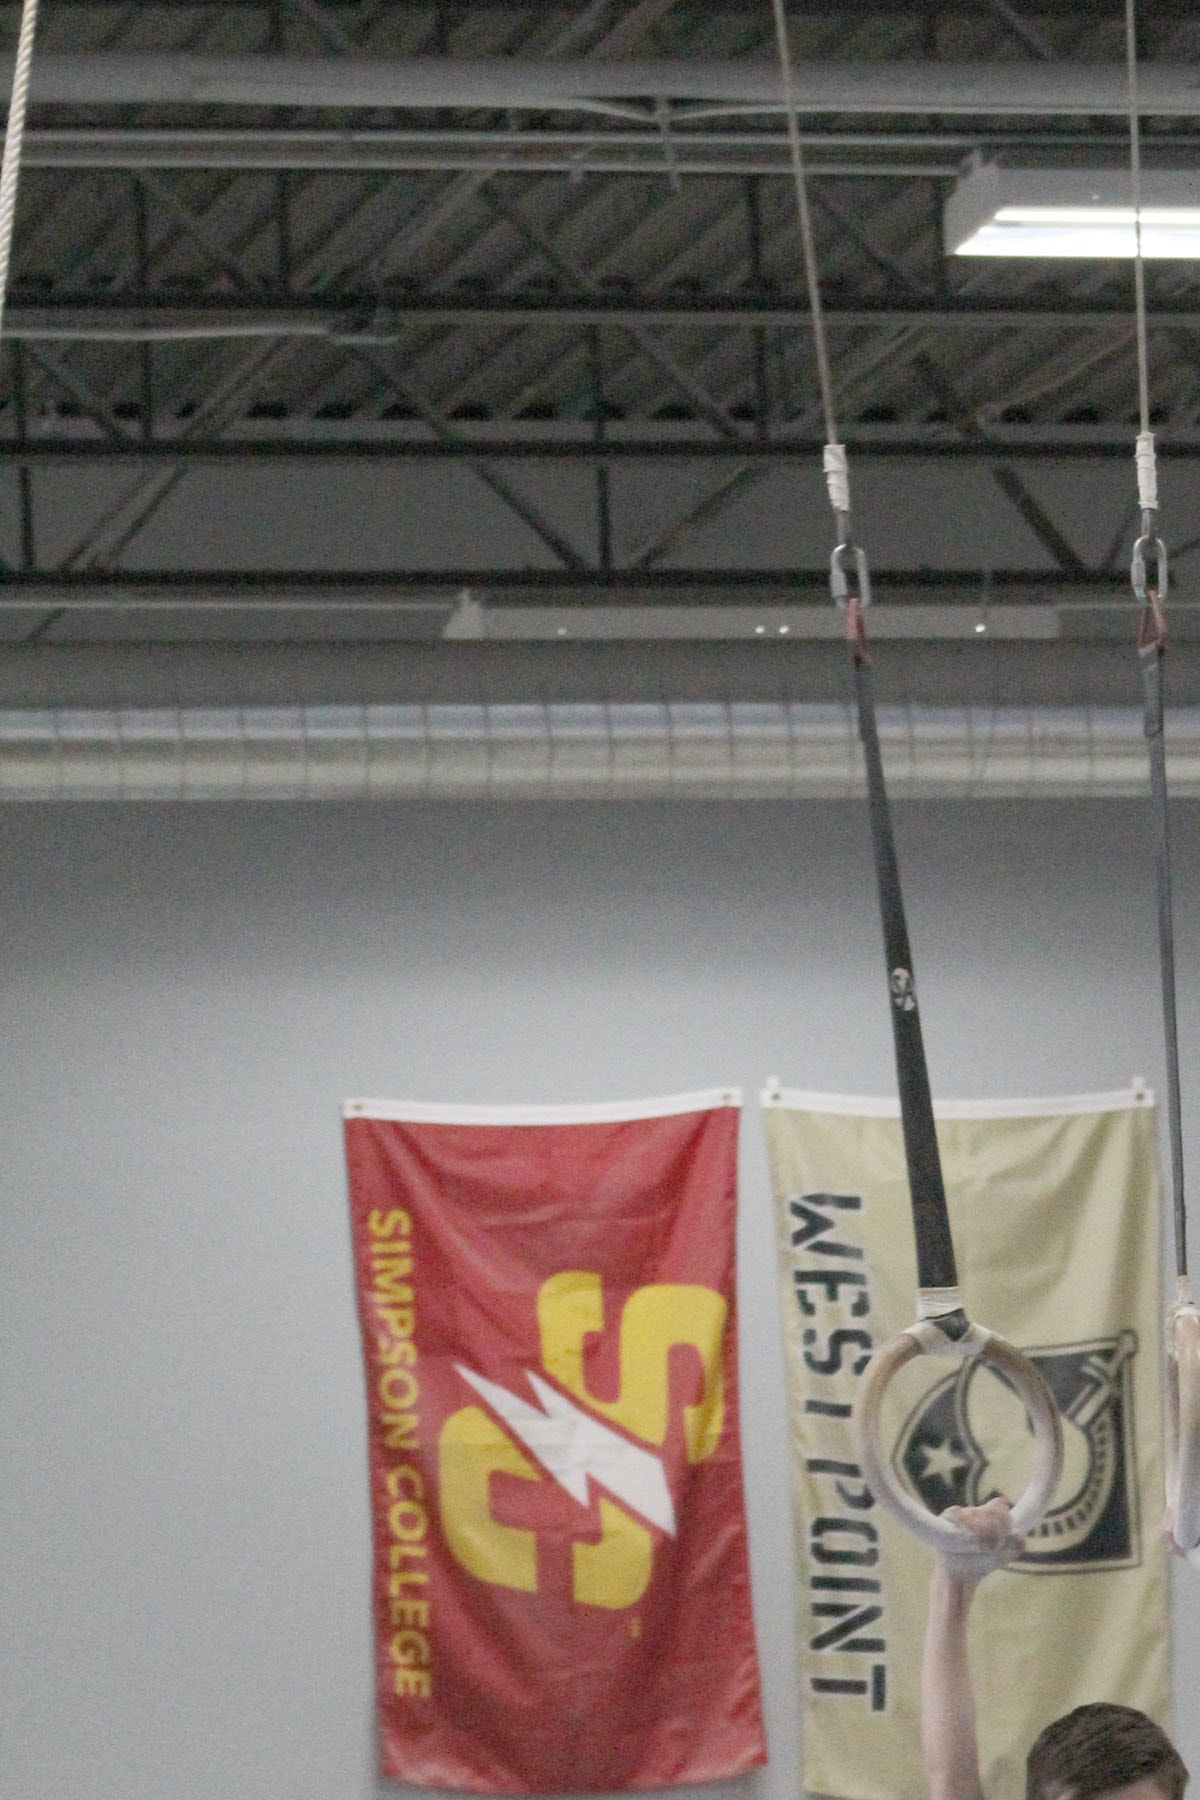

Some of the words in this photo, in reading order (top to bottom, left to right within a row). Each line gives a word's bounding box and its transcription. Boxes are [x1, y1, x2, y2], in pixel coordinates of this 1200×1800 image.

[367, 1208, 420, 1450] SIMPSON
[386, 1464, 433, 1698] COLLEGE
[805, 1458, 887, 1712] POINT
